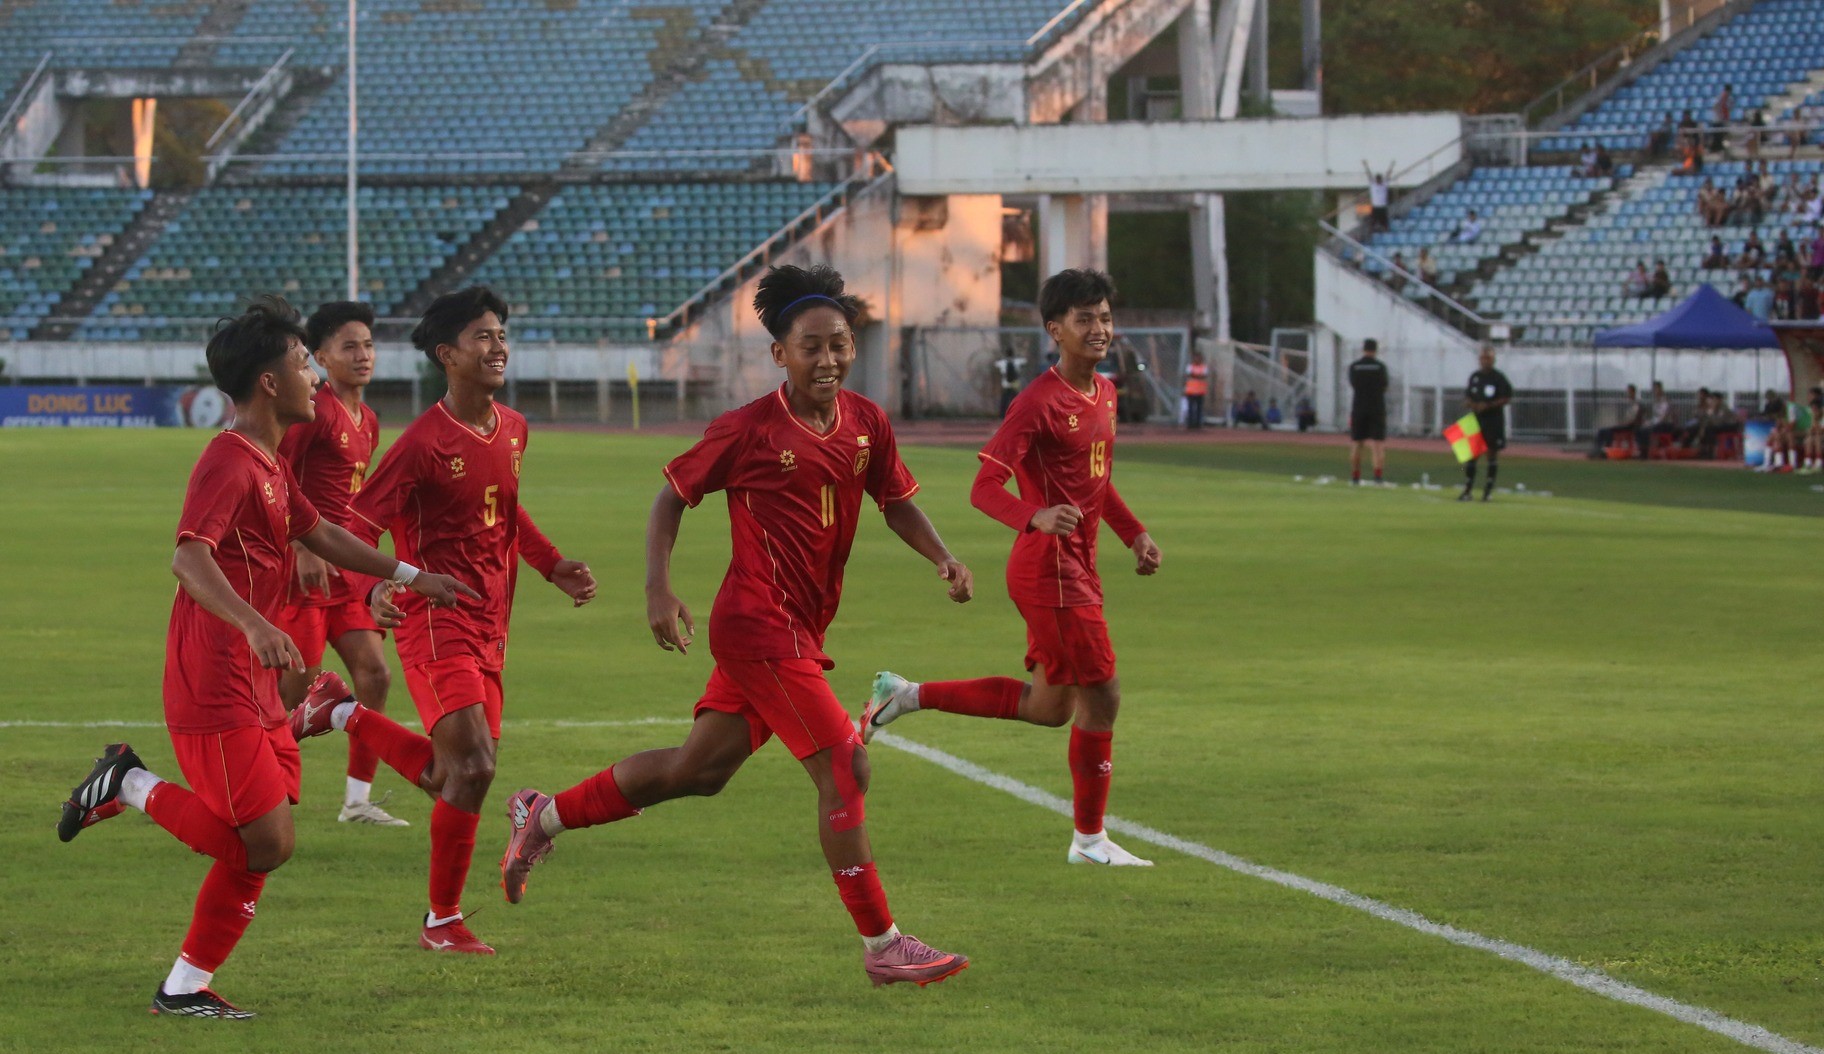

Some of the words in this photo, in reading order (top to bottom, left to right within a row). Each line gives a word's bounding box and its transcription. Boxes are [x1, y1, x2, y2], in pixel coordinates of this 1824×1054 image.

[29, 394, 87, 412] DONG
[95, 394, 132, 412] LUC
[1090, 440, 1106, 479] 19
[484, 484, 499, 527] 5
[820, 483, 836, 529] 11
